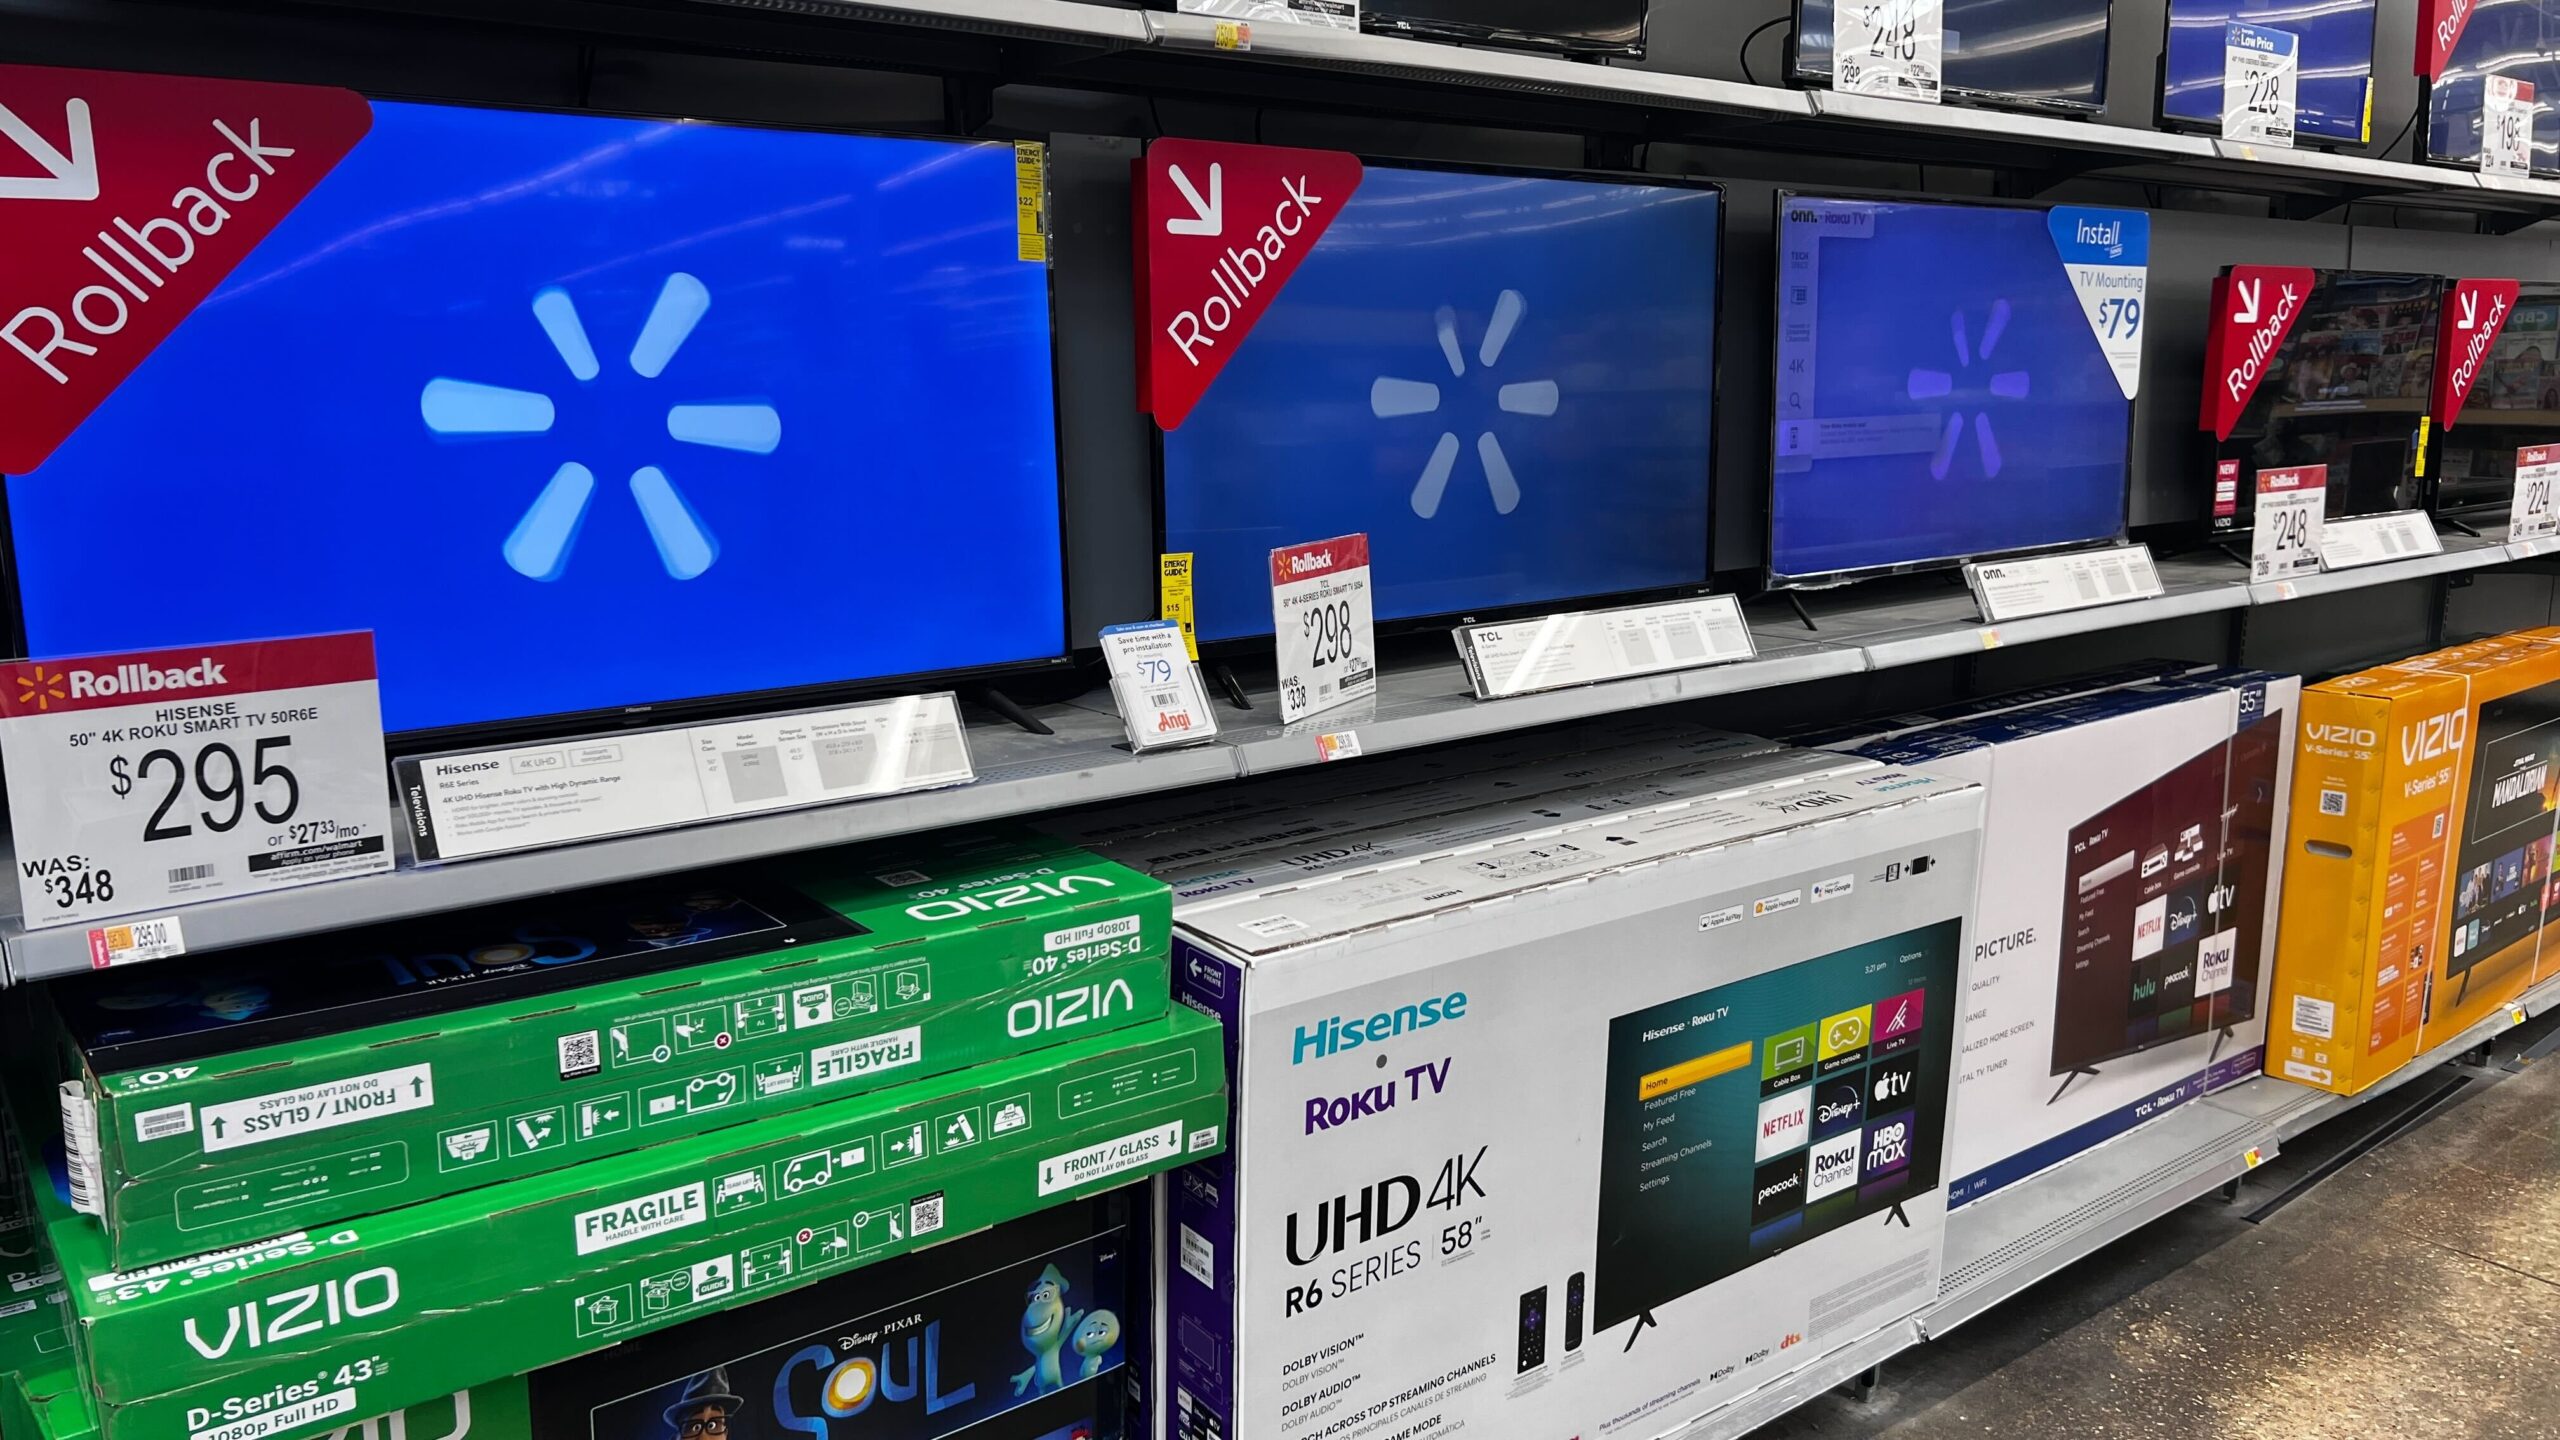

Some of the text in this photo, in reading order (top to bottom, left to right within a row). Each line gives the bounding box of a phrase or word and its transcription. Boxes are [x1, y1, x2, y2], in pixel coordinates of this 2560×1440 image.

[1396, 21, 1411, 30] TCL
[2241, 33, 2274, 51] Low Price
[2244, 69, 2279, 115] $228
[1016, 156, 1036, 164] GUIDE
[1018, 197, 1034, 206] $22
[1791, 210, 1866, 225] onn. Roku TV
[2076, 217, 2121, 246] Install
[0, 117, 296, 385] Rollback
[1166, 174, 1323, 366] Rollback
[2079, 271, 2143, 293] TV Mounting
[2099, 298, 2141, 340] $79
[2227, 282, 2298, 402] Rollback
[2451, 293, 2506, 397] Rollback
[1788, 359, 1805, 373] 4K
[2219, 464, 2236, 475] NEW
[2269, 473, 2300, 487] Rollback
[2526, 480, 2551, 515] $224
[2214, 517, 2232, 527] VIZIO
[2272, 508, 2308, 551] $248
[1164, 568, 1183, 577] GUIDE
[1291, 549, 1333, 575] Rollback
[1983, 567, 2006, 580] onn.
[1166, 604, 1180, 613] $15
[1463, 616, 1476, 624] TCL
[1303, 600, 1353, 669] $298
[1478, 631, 1503, 643] TCL
[1122, 641, 1173, 656] pro installation
[1136, 659, 1172, 684] $79
[1467, 645, 1482, 681] Televisions
[68, 658, 228, 699] Rollback
[155, 702, 237, 723] HISENSE
[2239, 687, 2262, 714] 55"
[69, 707, 319, 748] 50" 4K ROKU SMART TV 50R6E
[1158, 709, 1192, 732] Angi
[2306, 722, 2377, 747] VIZIO
[2401, 707, 2467, 767] VIZIO
[436, 756, 557, 776] Hisense 4K UHD
[110, 735, 301, 842] $295
[2491, 765, 2548, 809] MANDALORIAN
[409, 784, 428, 838] Televisions
[270, 840, 363, 860] affirm.com/walmart
[22, 855, 91, 878] WAS:
[44, 869, 115, 909] $348
[905, 872, 1116, 921] VIZIO
[1054, 919, 1131, 945] 1080p Full HD
[2137, 915, 2162, 940] NETFLIX
[1974, 927, 2037, 962] PICTURE.
[2203, 948, 2230, 969] Roku
[1203, 965, 1222, 979] FRONT
[1971, 975, 2001, 992] QUALITY
[2164, 965, 2190, 990] peacock
[800, 993, 824, 1004] GUIDE
[2133, 978, 2156, 1001] hulu
[1007, 978, 1133, 1038] VIZIO
[1182, 991, 1222, 1021] Hisense
[1292, 991, 1467, 1066] Hisense
[1642, 1006, 1729, 1043] Hisense Roku TV
[830, 1035, 898, 1057] HANDLE WITH CARE
[817, 1041, 914, 1080] FRAGILE
[1824, 1053, 1861, 1070] Game console
[1645, 1076, 1669, 1091] Home
[1773, 1073, 1801, 1089] Cable Box
[259, 1078, 379, 1111] DO NOT LAY ON GLASS
[1305, 1057, 1451, 1136] Roku TV
[1643, 1086, 1697, 1112] Featured Free
[2136, 1086, 2186, 1118] TCL Roku TV
[243, 1088, 396, 1133] FRONT / GLASS
[1642, 1113, 1675, 1133] My Feed
[1763, 1108, 1805, 1139] NETFLIX
[1817, 1098, 1861, 1124] Disney+
[1642, 1135, 1668, 1152] Search
[1873, 1122, 1905, 1150] HBO
[1063, 1134, 1160, 1175] FRONT / GLASS
[1074, 1152, 1149, 1182] DO NOT LAY ON GLASS
[1640, 1138, 1713, 1173] Streaming Channels
[1815, 1145, 1855, 1174] Roku
[1866, 1139, 1907, 1171] max
[1639, 1174, 1671, 1193] Settings
[1813, 1164, 1854, 1188] Channel
[1758, 1173, 1799, 1206] peacock
[585, 1189, 699, 1238] FRAGILE
[1286, 1145, 1488, 1266] UHD 4K
[605, 1213, 685, 1242] HANDLE WITH CARE
[1285, 1216, 1483, 1319] R6 SERIES 58"
[700, 1280, 726, 1295] GUIDE
[184, 1267, 400, 1360] VIZIO
[838, 1313, 923, 1353] Disney PIXAR
[1780, 1332, 1802, 1350] dts
[1282, 1353, 1318, 1376] DOLBY
[1717, 1364, 1736, 1378] Dolby
[1281, 1394, 1317, 1417] DOLBY
[1324, 1411, 1366, 1439] ACROSS
[1367, 1401, 1388, 1418] TOP
[1389, 1375, 1446, 1408] STREAMING
[1446, 1353, 1497, 1383] CHANNELS
[1352, 1412, 1400, 1440] PRINCIPALES
[1400, 1396, 1434, 1419] CANALES
[1434, 1392, 1446, 1402] DE
[1446, 1373, 1488, 1397] STREAMING
[208, 1399, 340, 1440] 1080p Full HD
